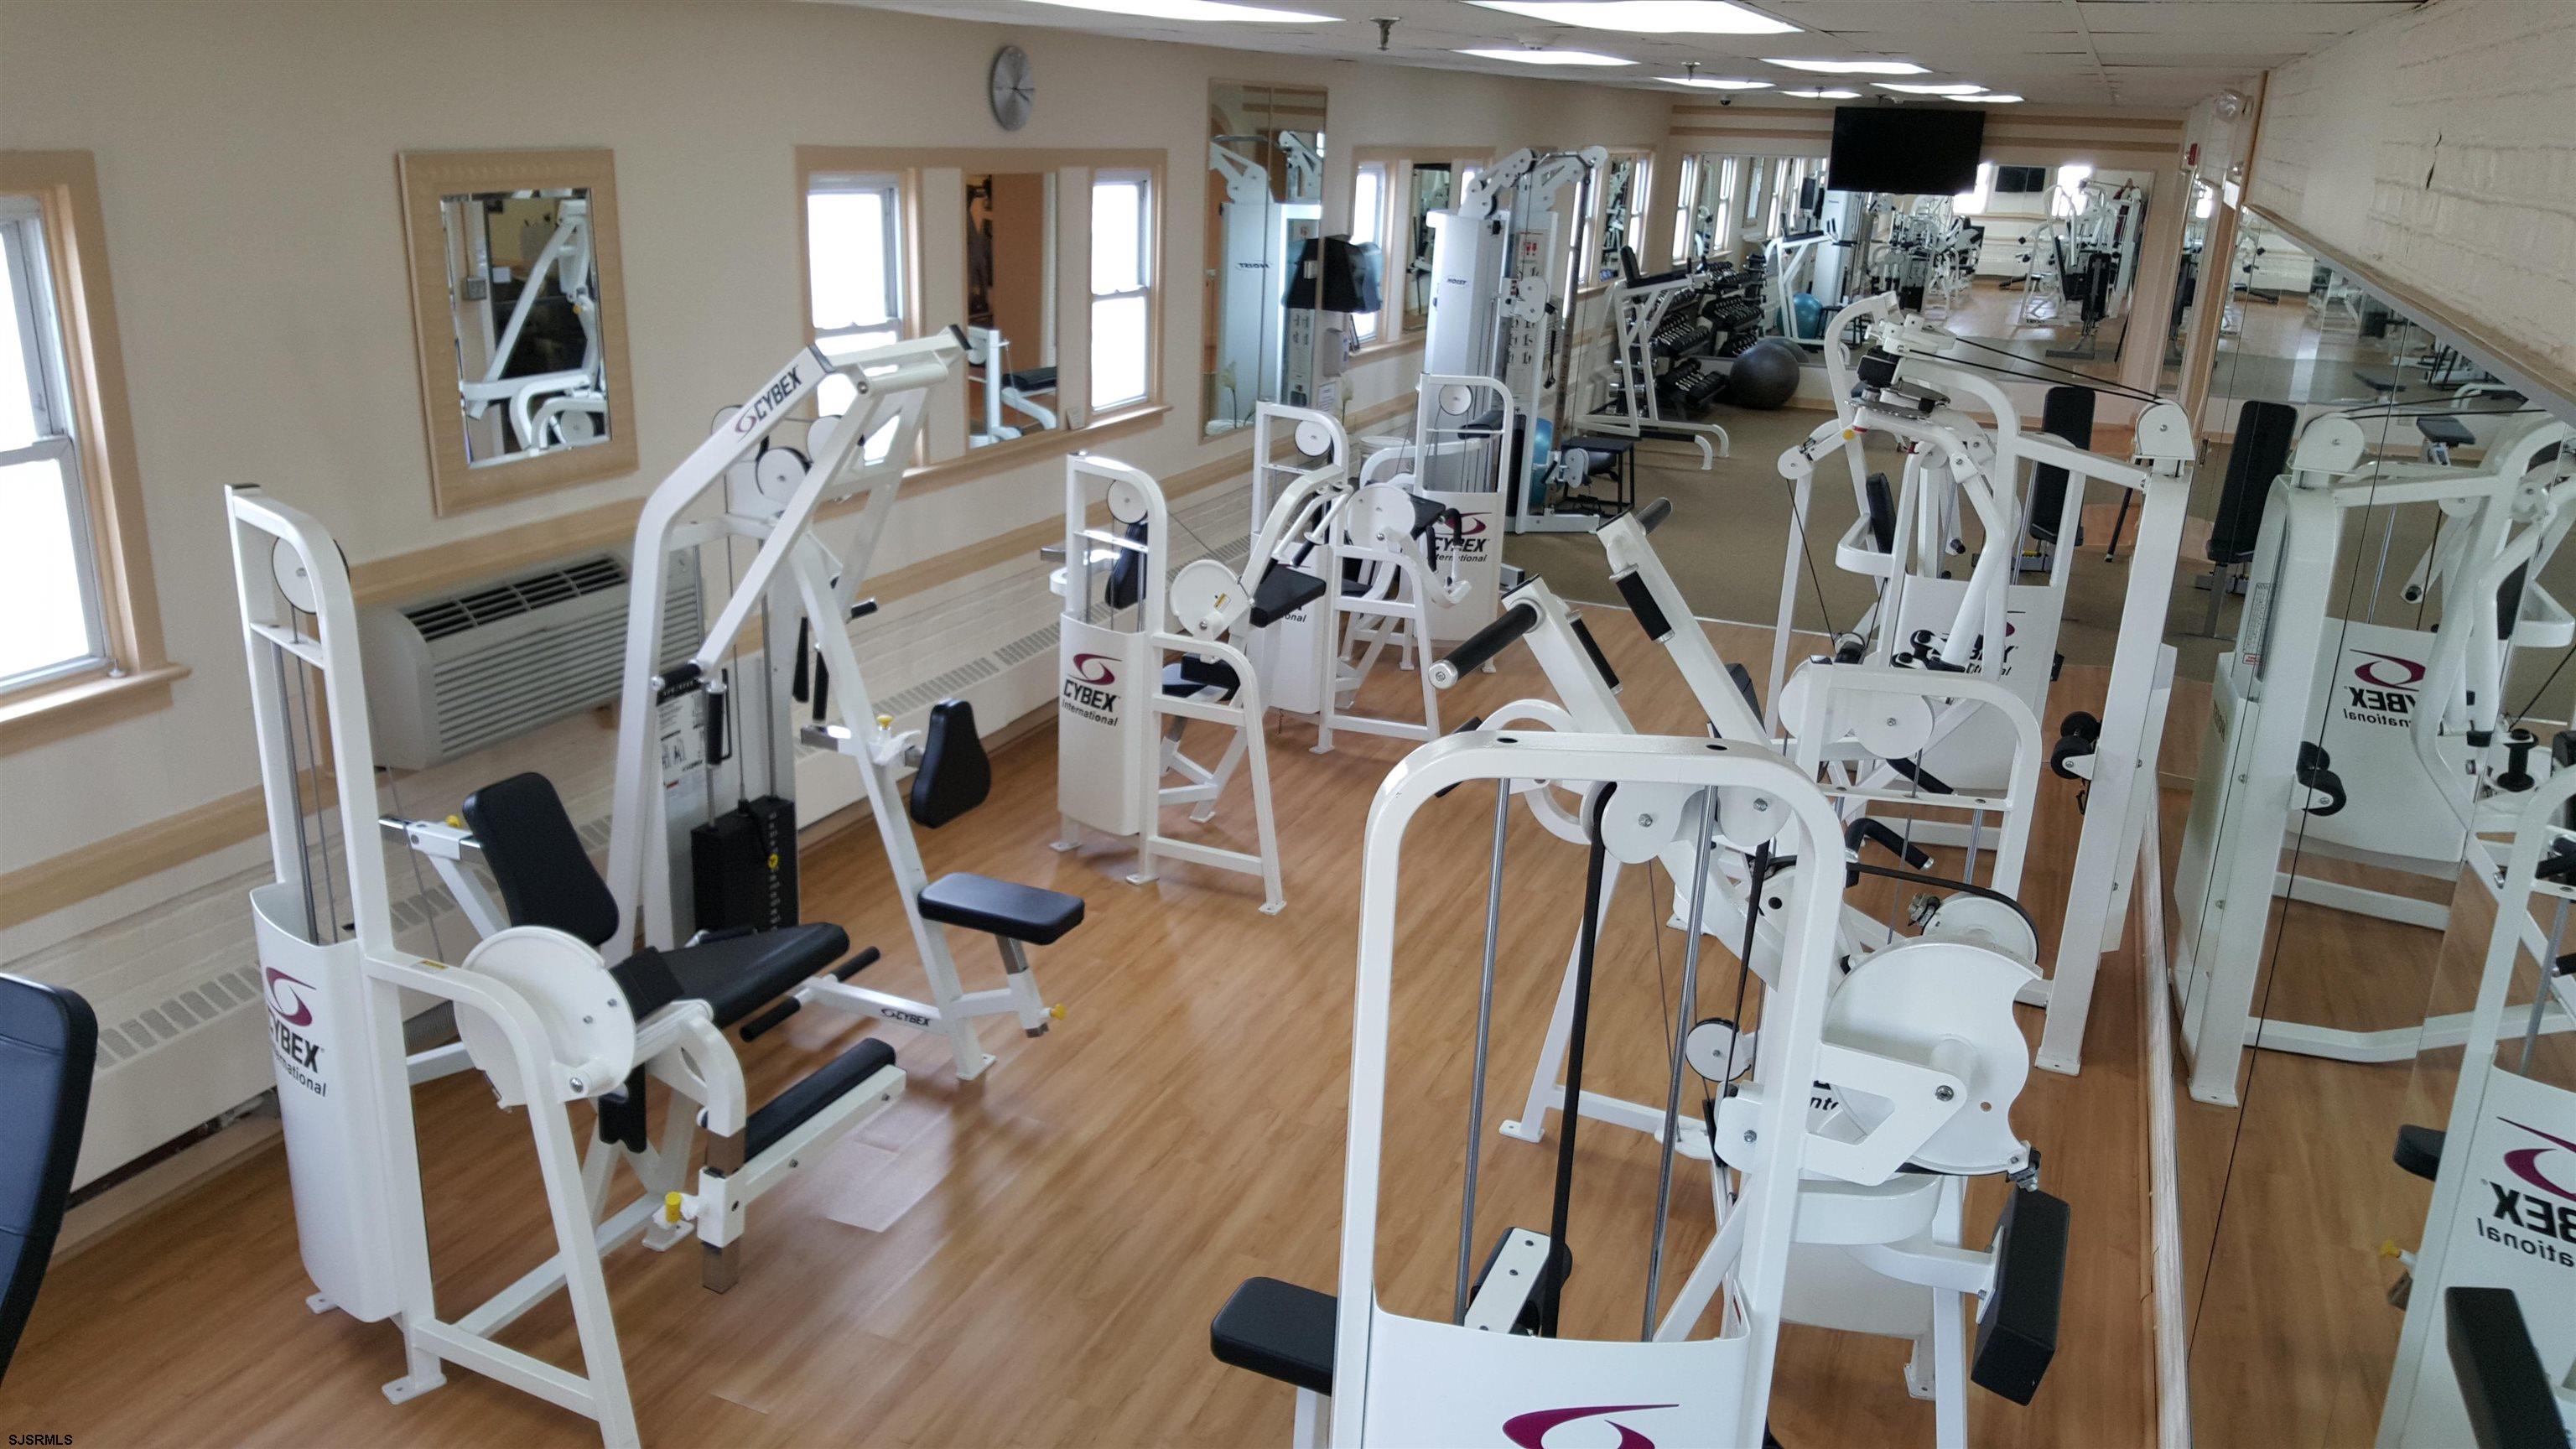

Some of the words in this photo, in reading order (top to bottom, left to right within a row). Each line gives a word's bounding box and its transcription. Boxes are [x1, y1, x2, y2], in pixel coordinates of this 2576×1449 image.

[754, 366, 802, 422] CYBEX
[1435, 538, 1487, 553] YEX
[1436, 553, 1488, 563] erntional
[1063, 679, 1118, 713] CYBEX
[1062, 699, 1118, 726] International
[896, 1010, 932, 1027] CYBEX
[275, 1049, 326, 1097] ernational
